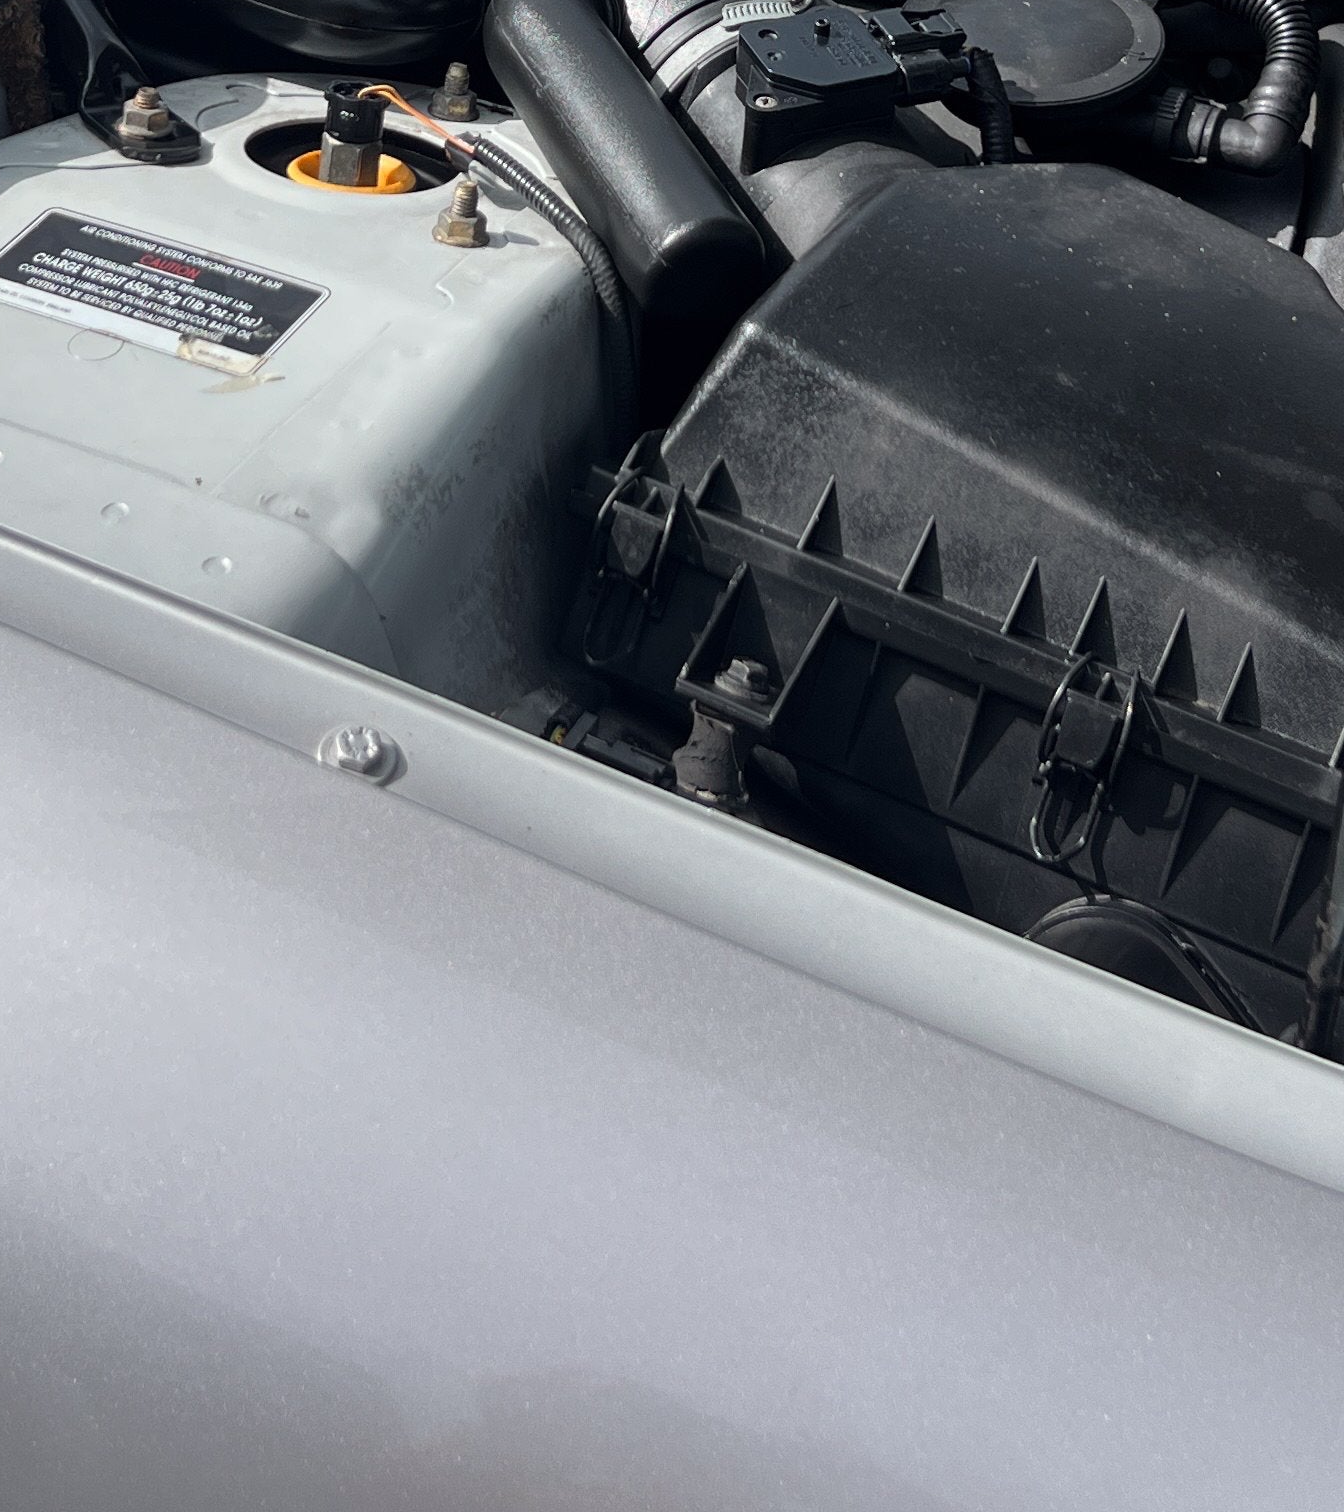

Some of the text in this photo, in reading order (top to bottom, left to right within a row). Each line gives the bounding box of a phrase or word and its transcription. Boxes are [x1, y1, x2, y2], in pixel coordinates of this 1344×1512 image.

[33, 252, 83, 272] CHARGE
[81, 267, 126, 285] WEIGHT
[61, 249, 253, 310] SYSTEM PRESSURISED WITH HFC REFRIGERANT 134a
[80, 224, 97, 233] AIR
[96, 230, 155, 250] CONDITIONING
[155, 247, 186, 259] SYSTEM
[185, 256, 233, 274] CONFORMS
[232, 270, 246, 278] TO
[244, 274, 262, 283] SAE
[138, 255, 200, 278] CAUTION
[18, 264, 74, 283] COMPRESSOR
[74, 280, 117, 297] LUBRICANT
[210, 321, 236, 332] BASED
[27, 278, 58, 290] SYSTEM
[57, 286, 71, 294] TO
[69, 290, 82, 298] BE
[81, 294, 121, 309] SERVICED
[120, 305, 133, 313] BY
[133, 310, 177, 326] QUALIFIED
